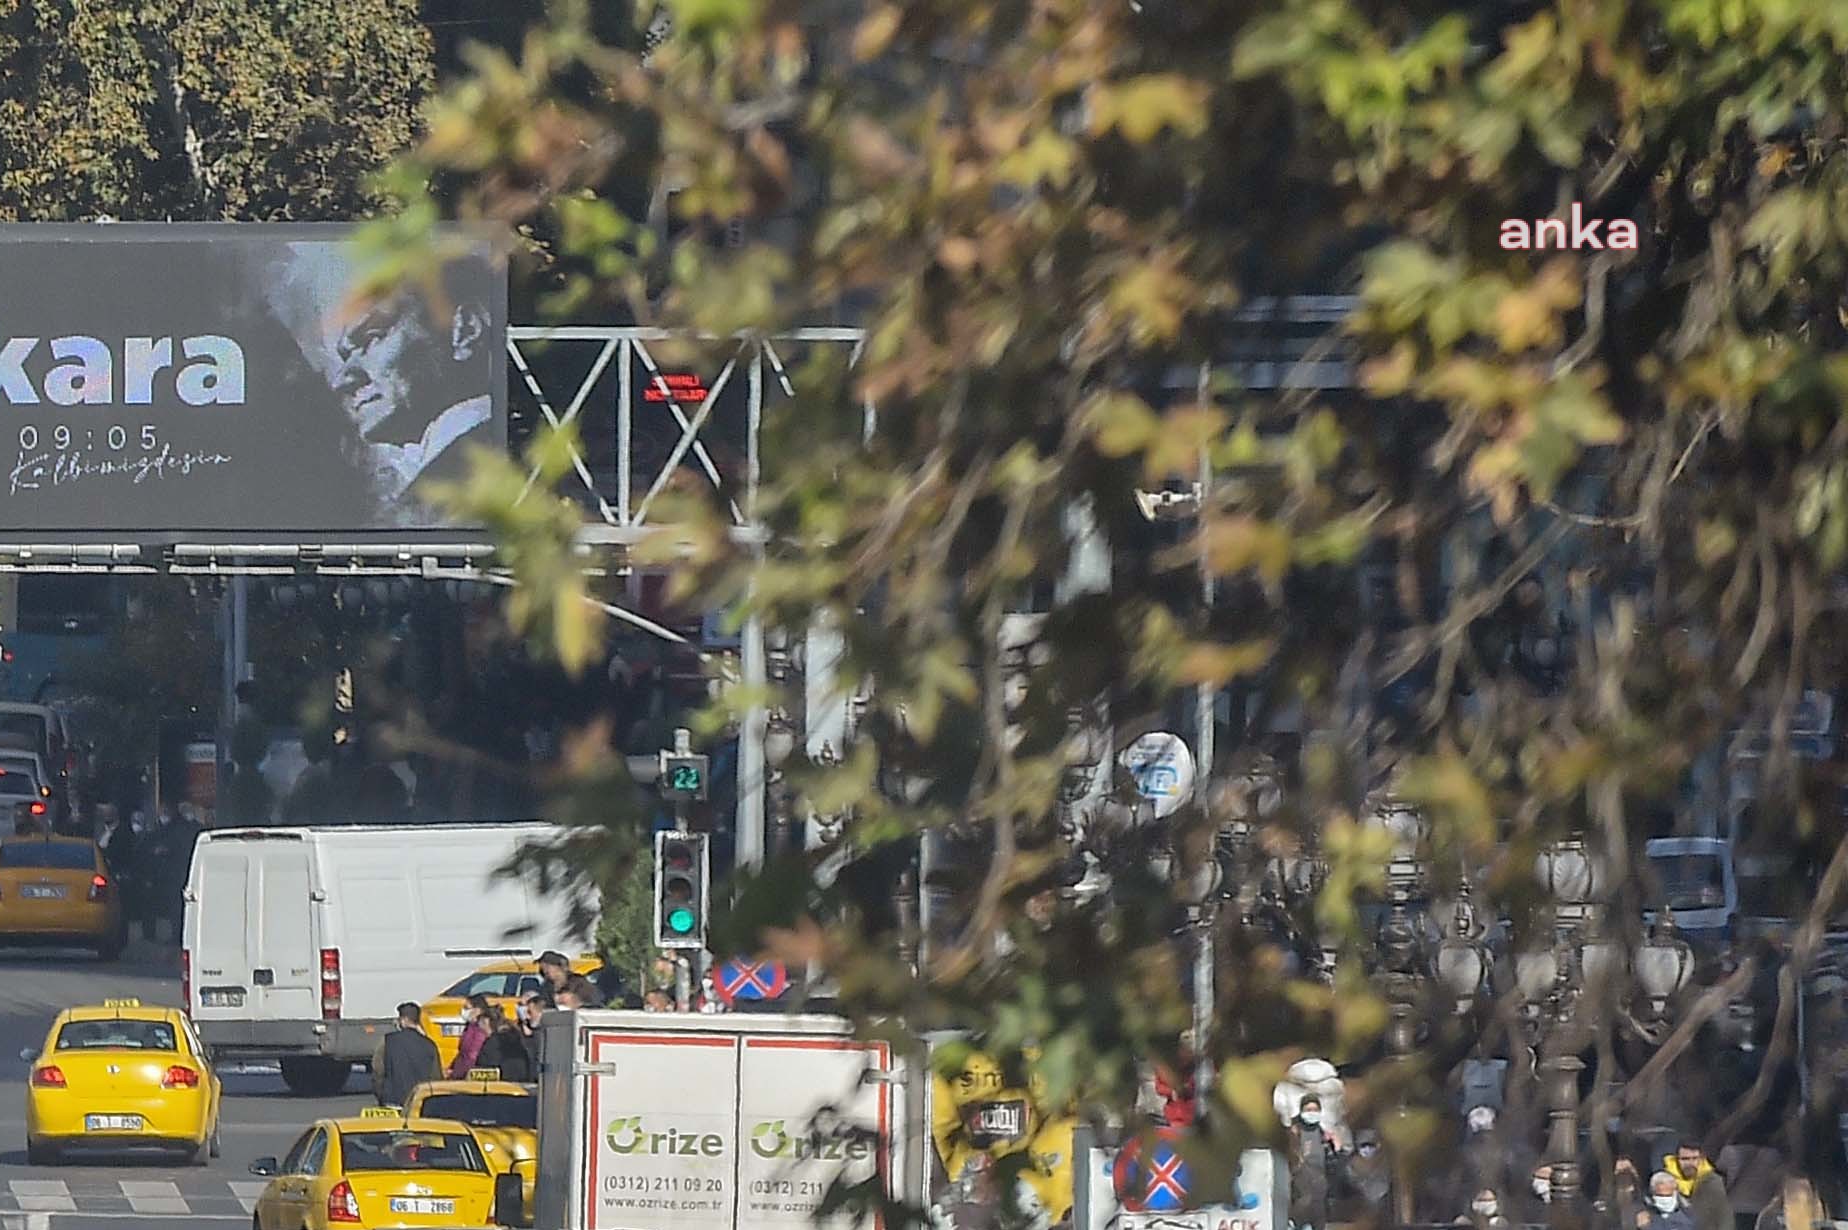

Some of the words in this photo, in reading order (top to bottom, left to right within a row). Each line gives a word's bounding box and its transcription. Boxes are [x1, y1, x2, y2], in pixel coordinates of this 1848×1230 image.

[18, 425, 158, 451] 09:05
[604, 1176, 650, 1193] (0312)
[654, 1177, 678, 1192] 211
[684, 1178, 701, 1193] 09
[706, 1178, 723, 1193] 20
[800, 1181, 823, 1195] 211
